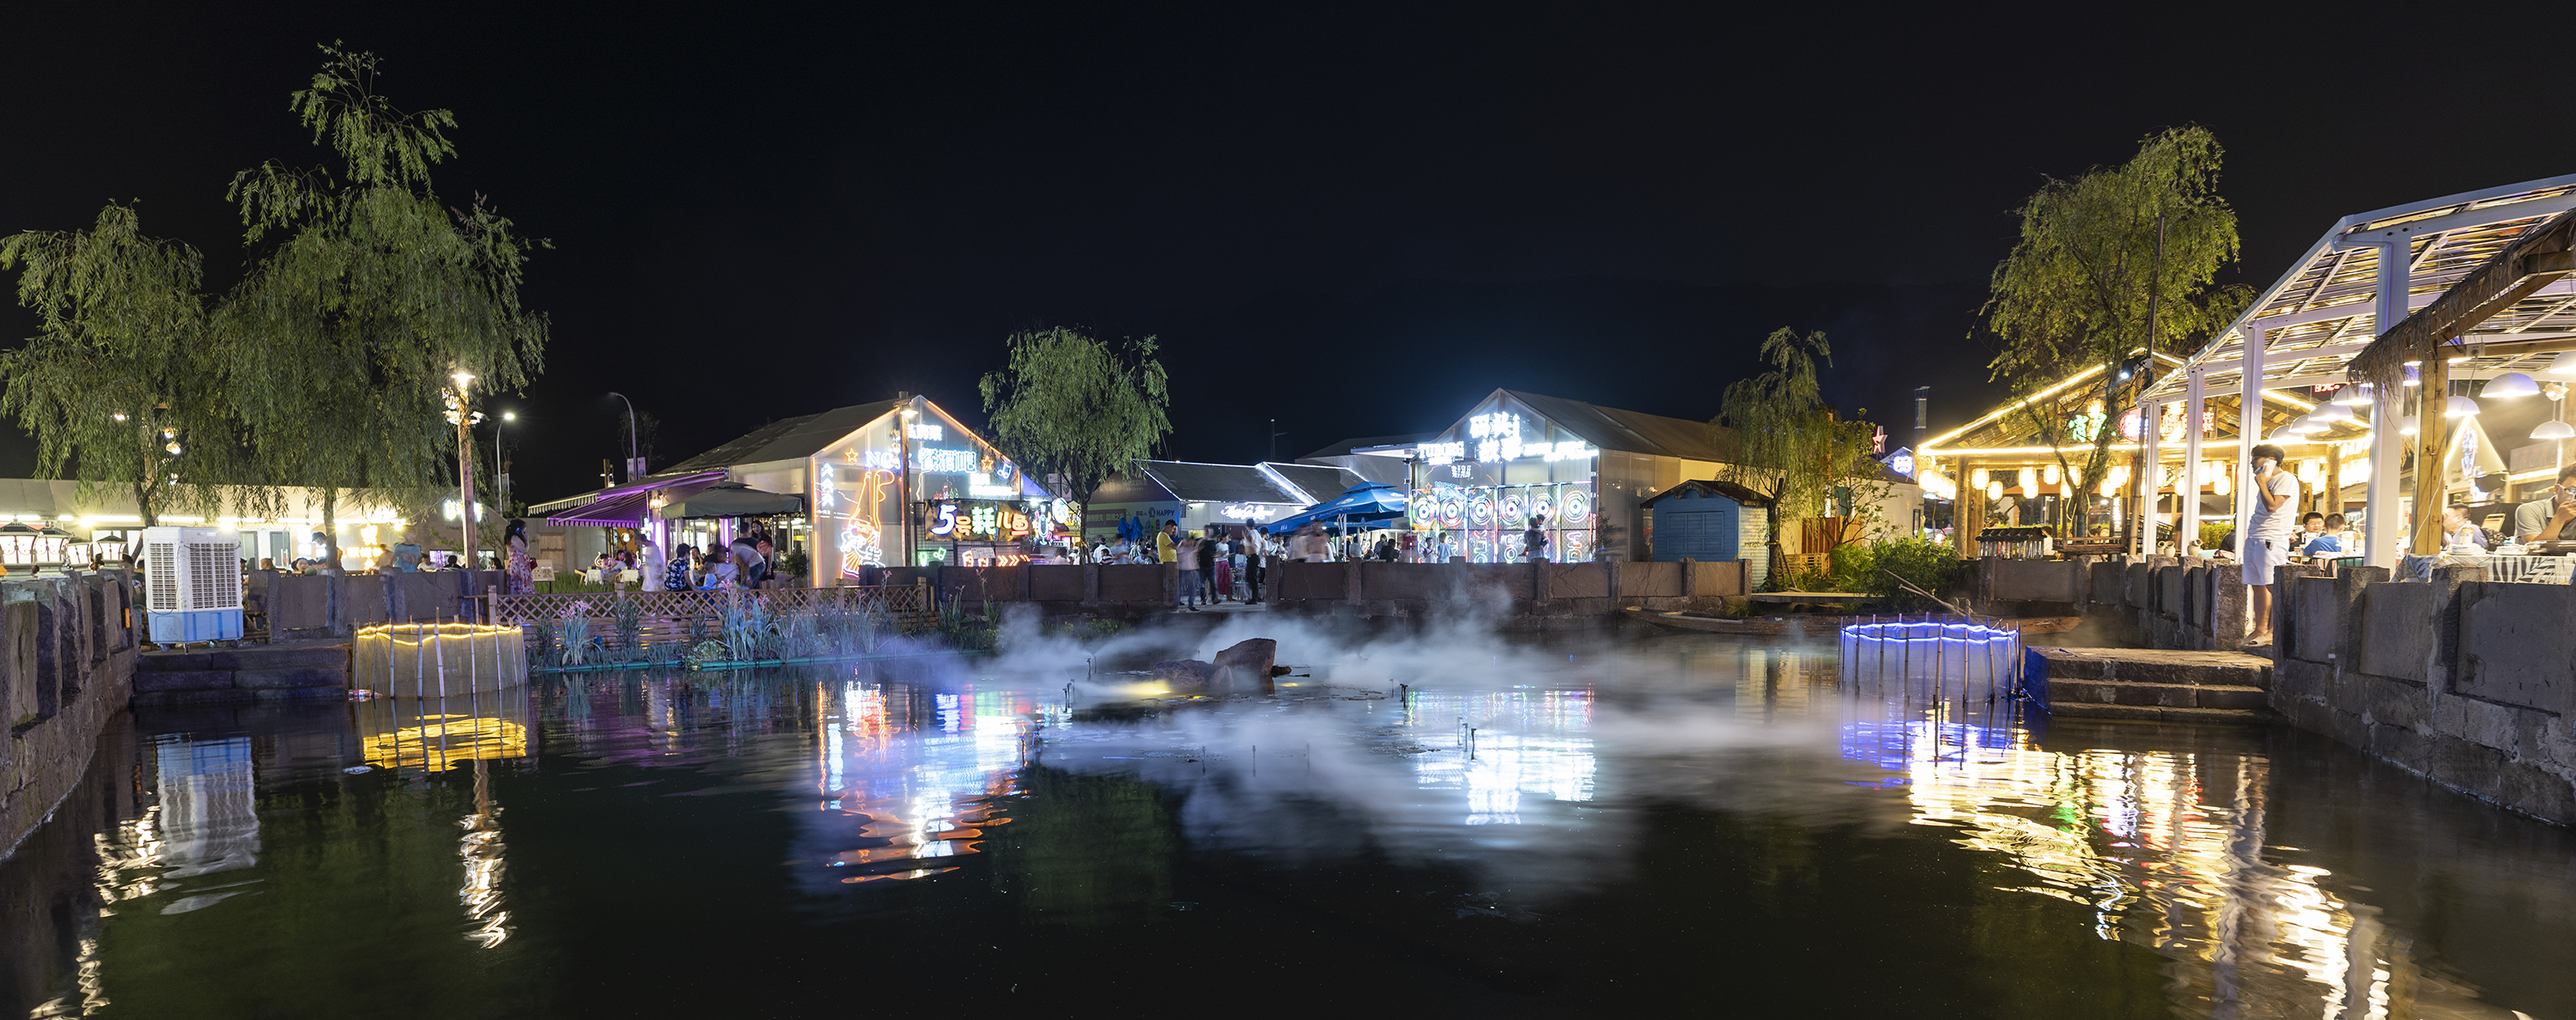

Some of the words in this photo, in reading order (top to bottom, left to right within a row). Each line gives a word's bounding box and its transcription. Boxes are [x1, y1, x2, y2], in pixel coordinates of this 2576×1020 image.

[918, 447, 977, 472] 餐酒吧
[930, 504, 1030, 537] 5号耗儿鱼
